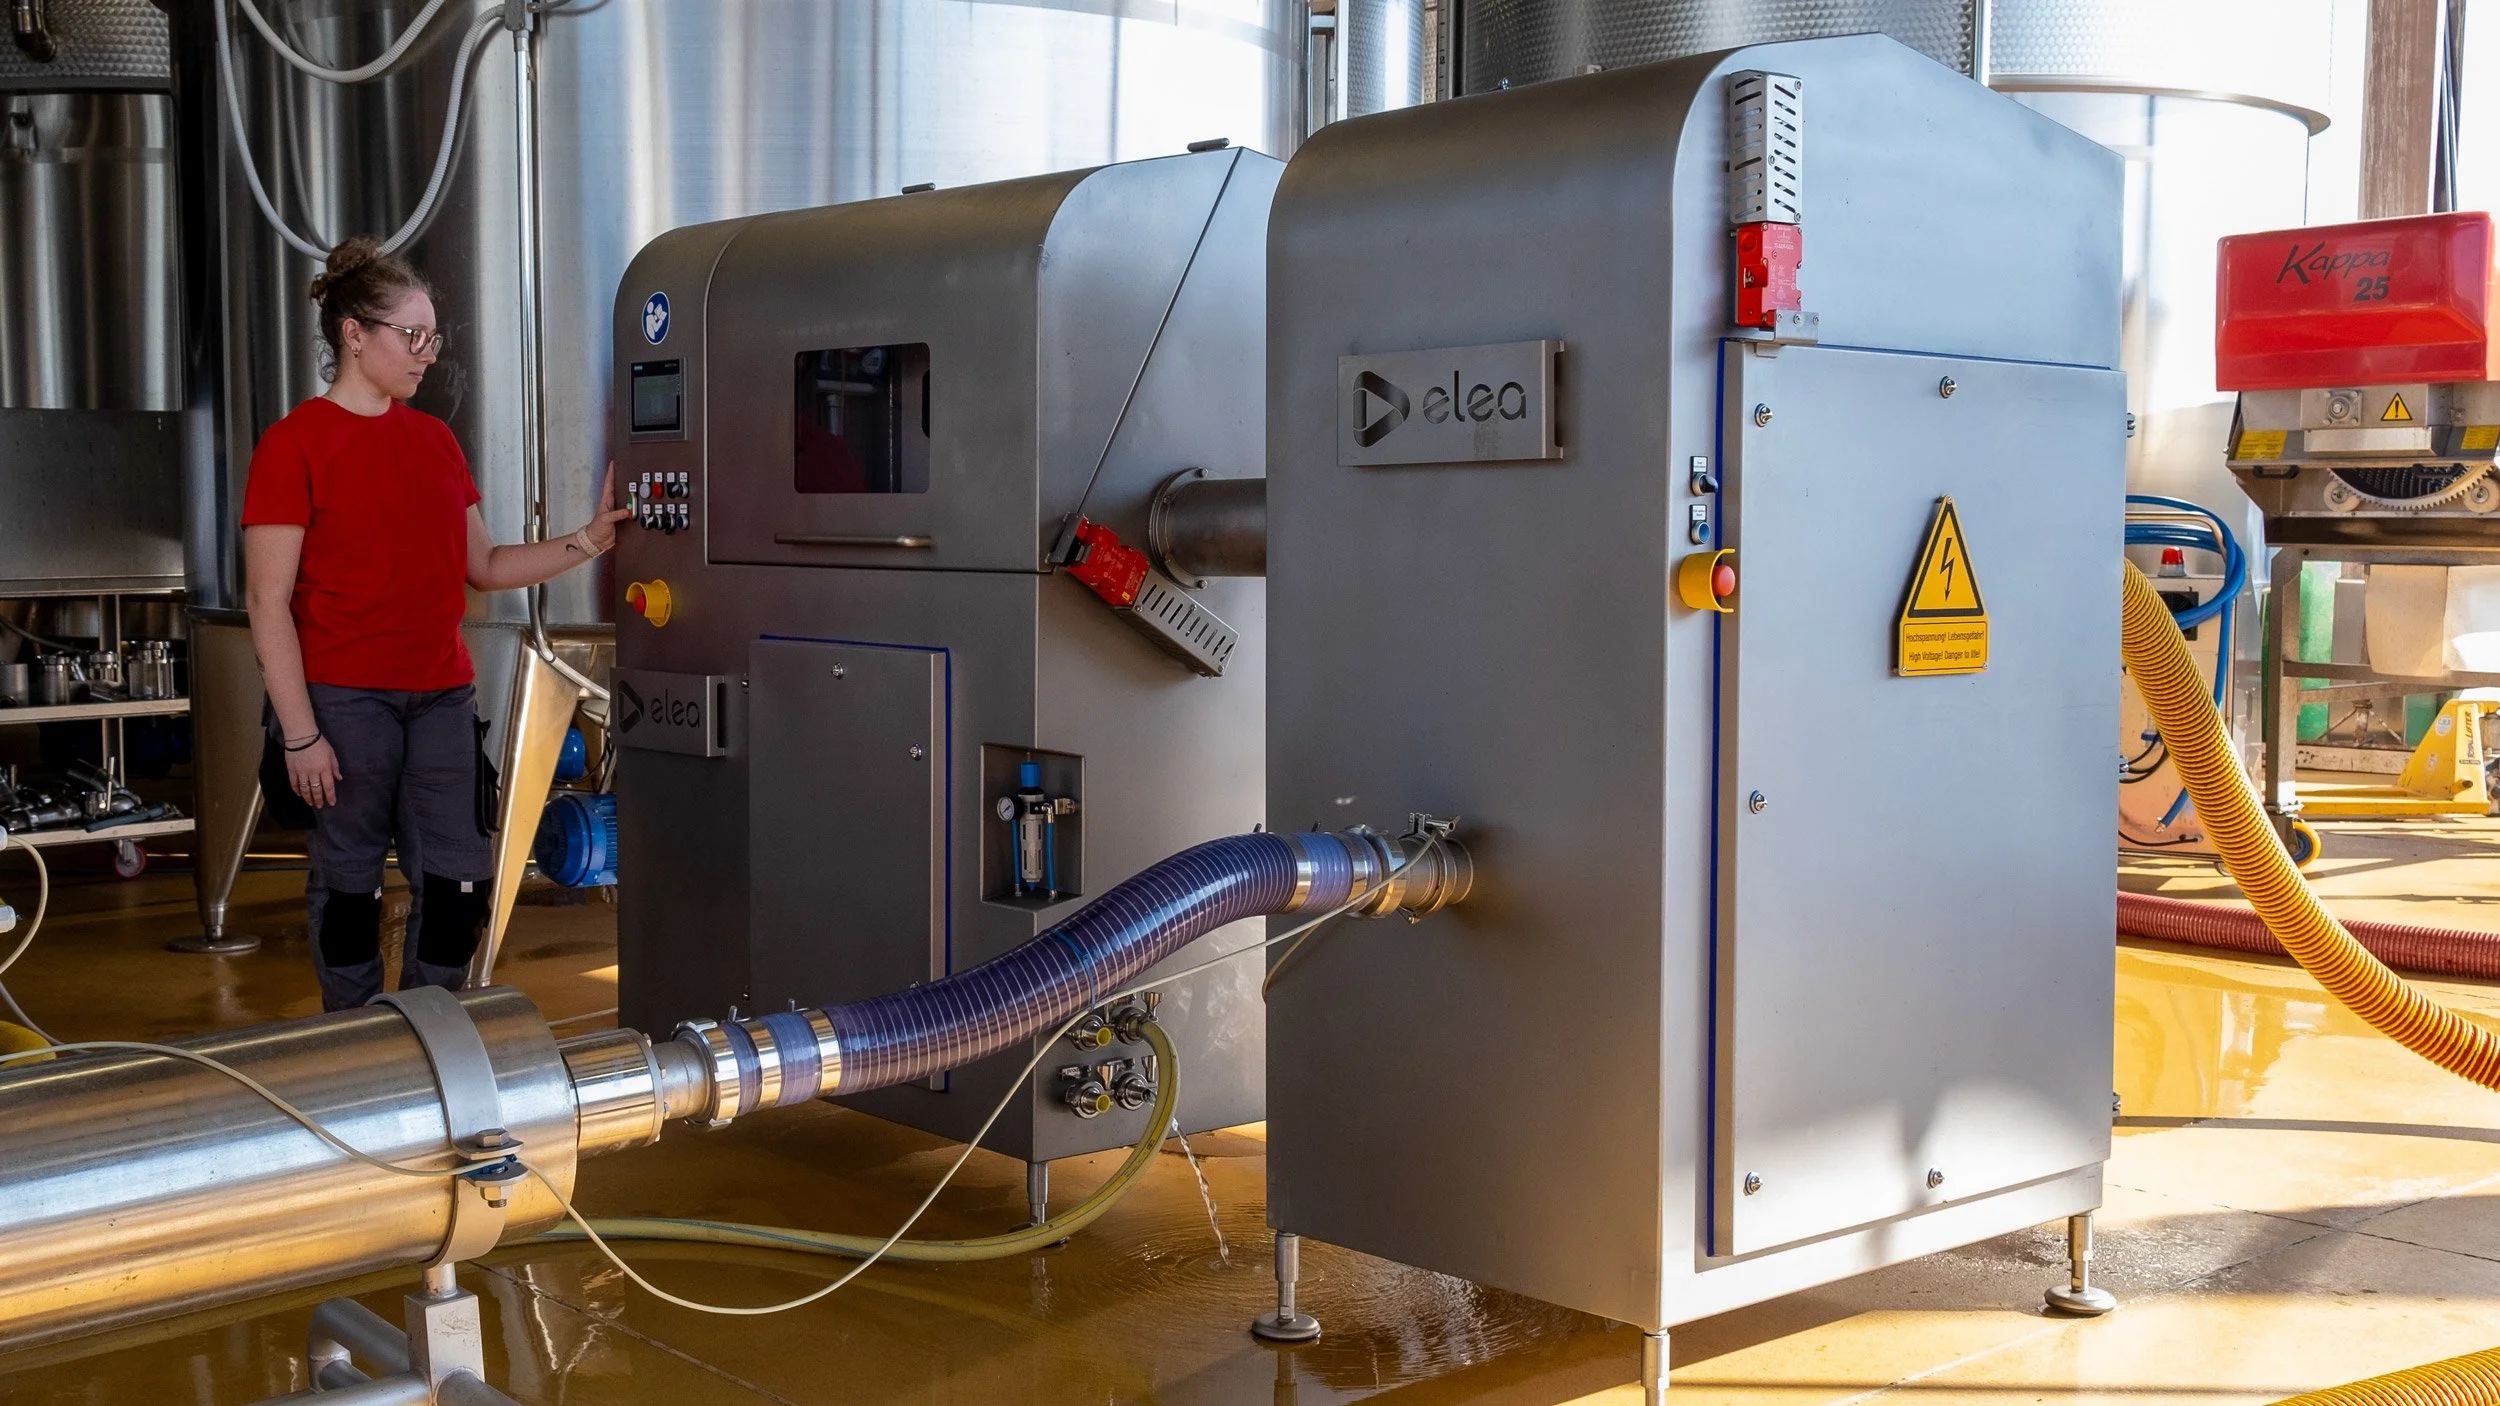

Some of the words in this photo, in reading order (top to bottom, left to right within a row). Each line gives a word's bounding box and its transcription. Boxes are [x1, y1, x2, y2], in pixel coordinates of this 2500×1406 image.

[2276, 240, 2391, 285] Kappa
[2354, 275, 2391, 302] 25
[1422, 370, 1527, 425] elea
[1905, 631, 1946, 643] Hochspannung!
[1948, 630, 1985, 642] Lebensgefahr!
[1908, 651, 1921, 662] High
[1922, 650, 1944, 662] Voltage!
[1944, 650, 1963, 661] Danger
[1964, 650, 1970, 659] to
[650, 687, 700, 728] elea
